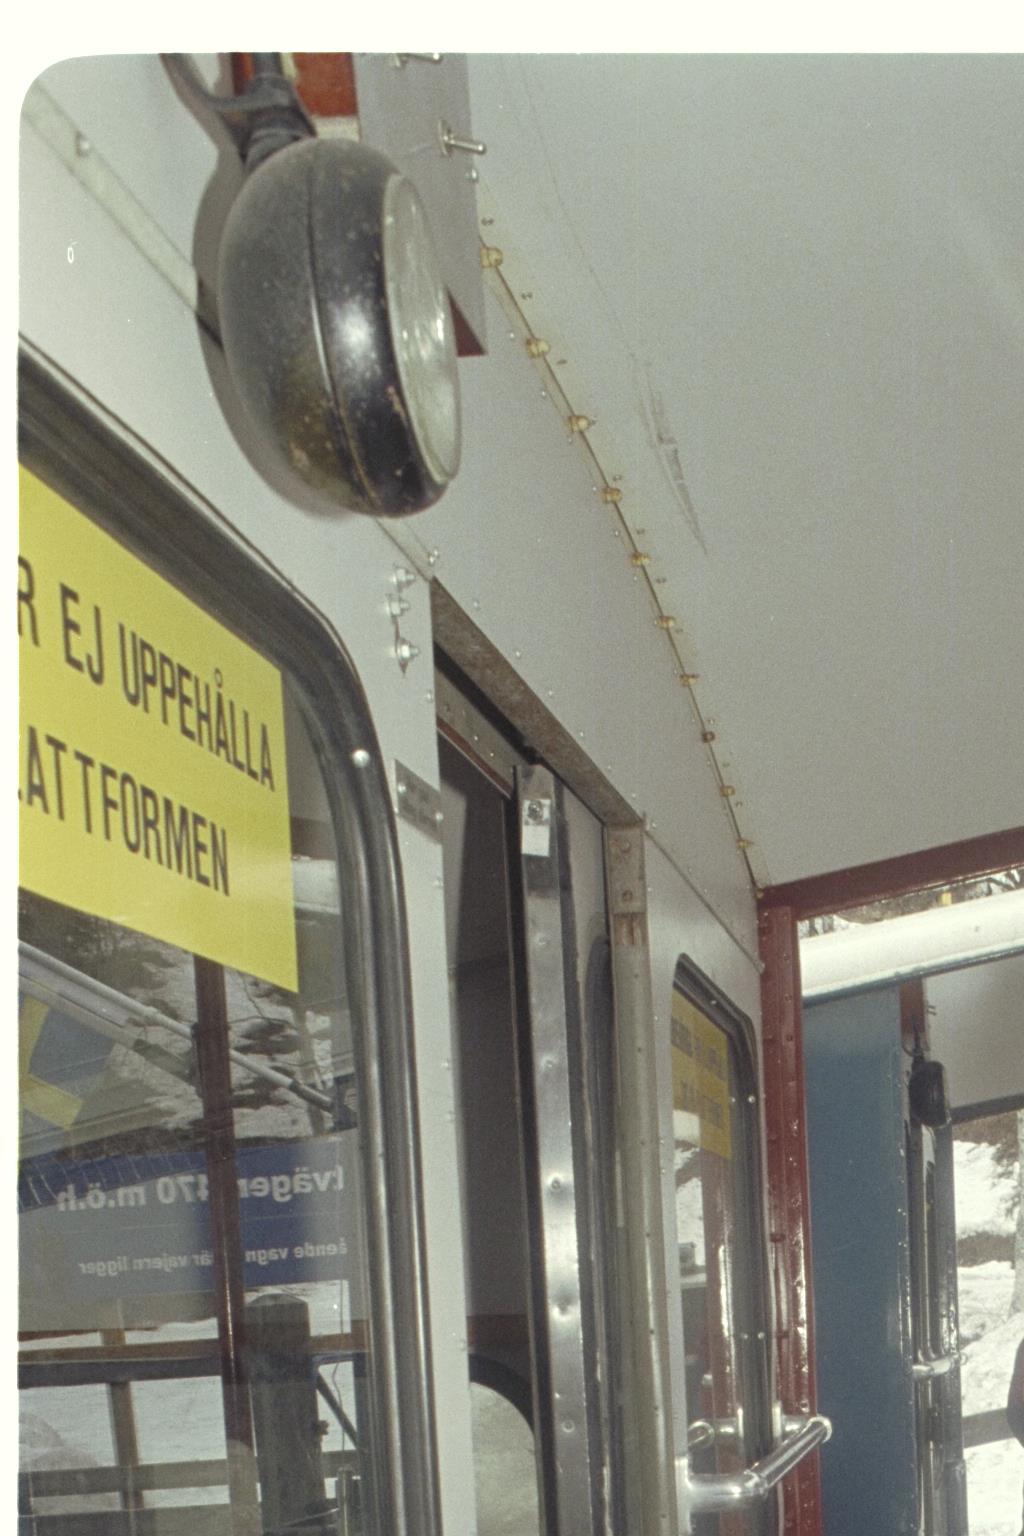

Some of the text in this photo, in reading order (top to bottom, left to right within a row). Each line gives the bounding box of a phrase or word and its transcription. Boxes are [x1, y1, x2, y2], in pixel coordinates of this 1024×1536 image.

[59, 582, 105, 687] EJ
[118, 622, 275, 793] UPPEHÅLLA
[18, 725, 230, 898] ATTFORMEN
